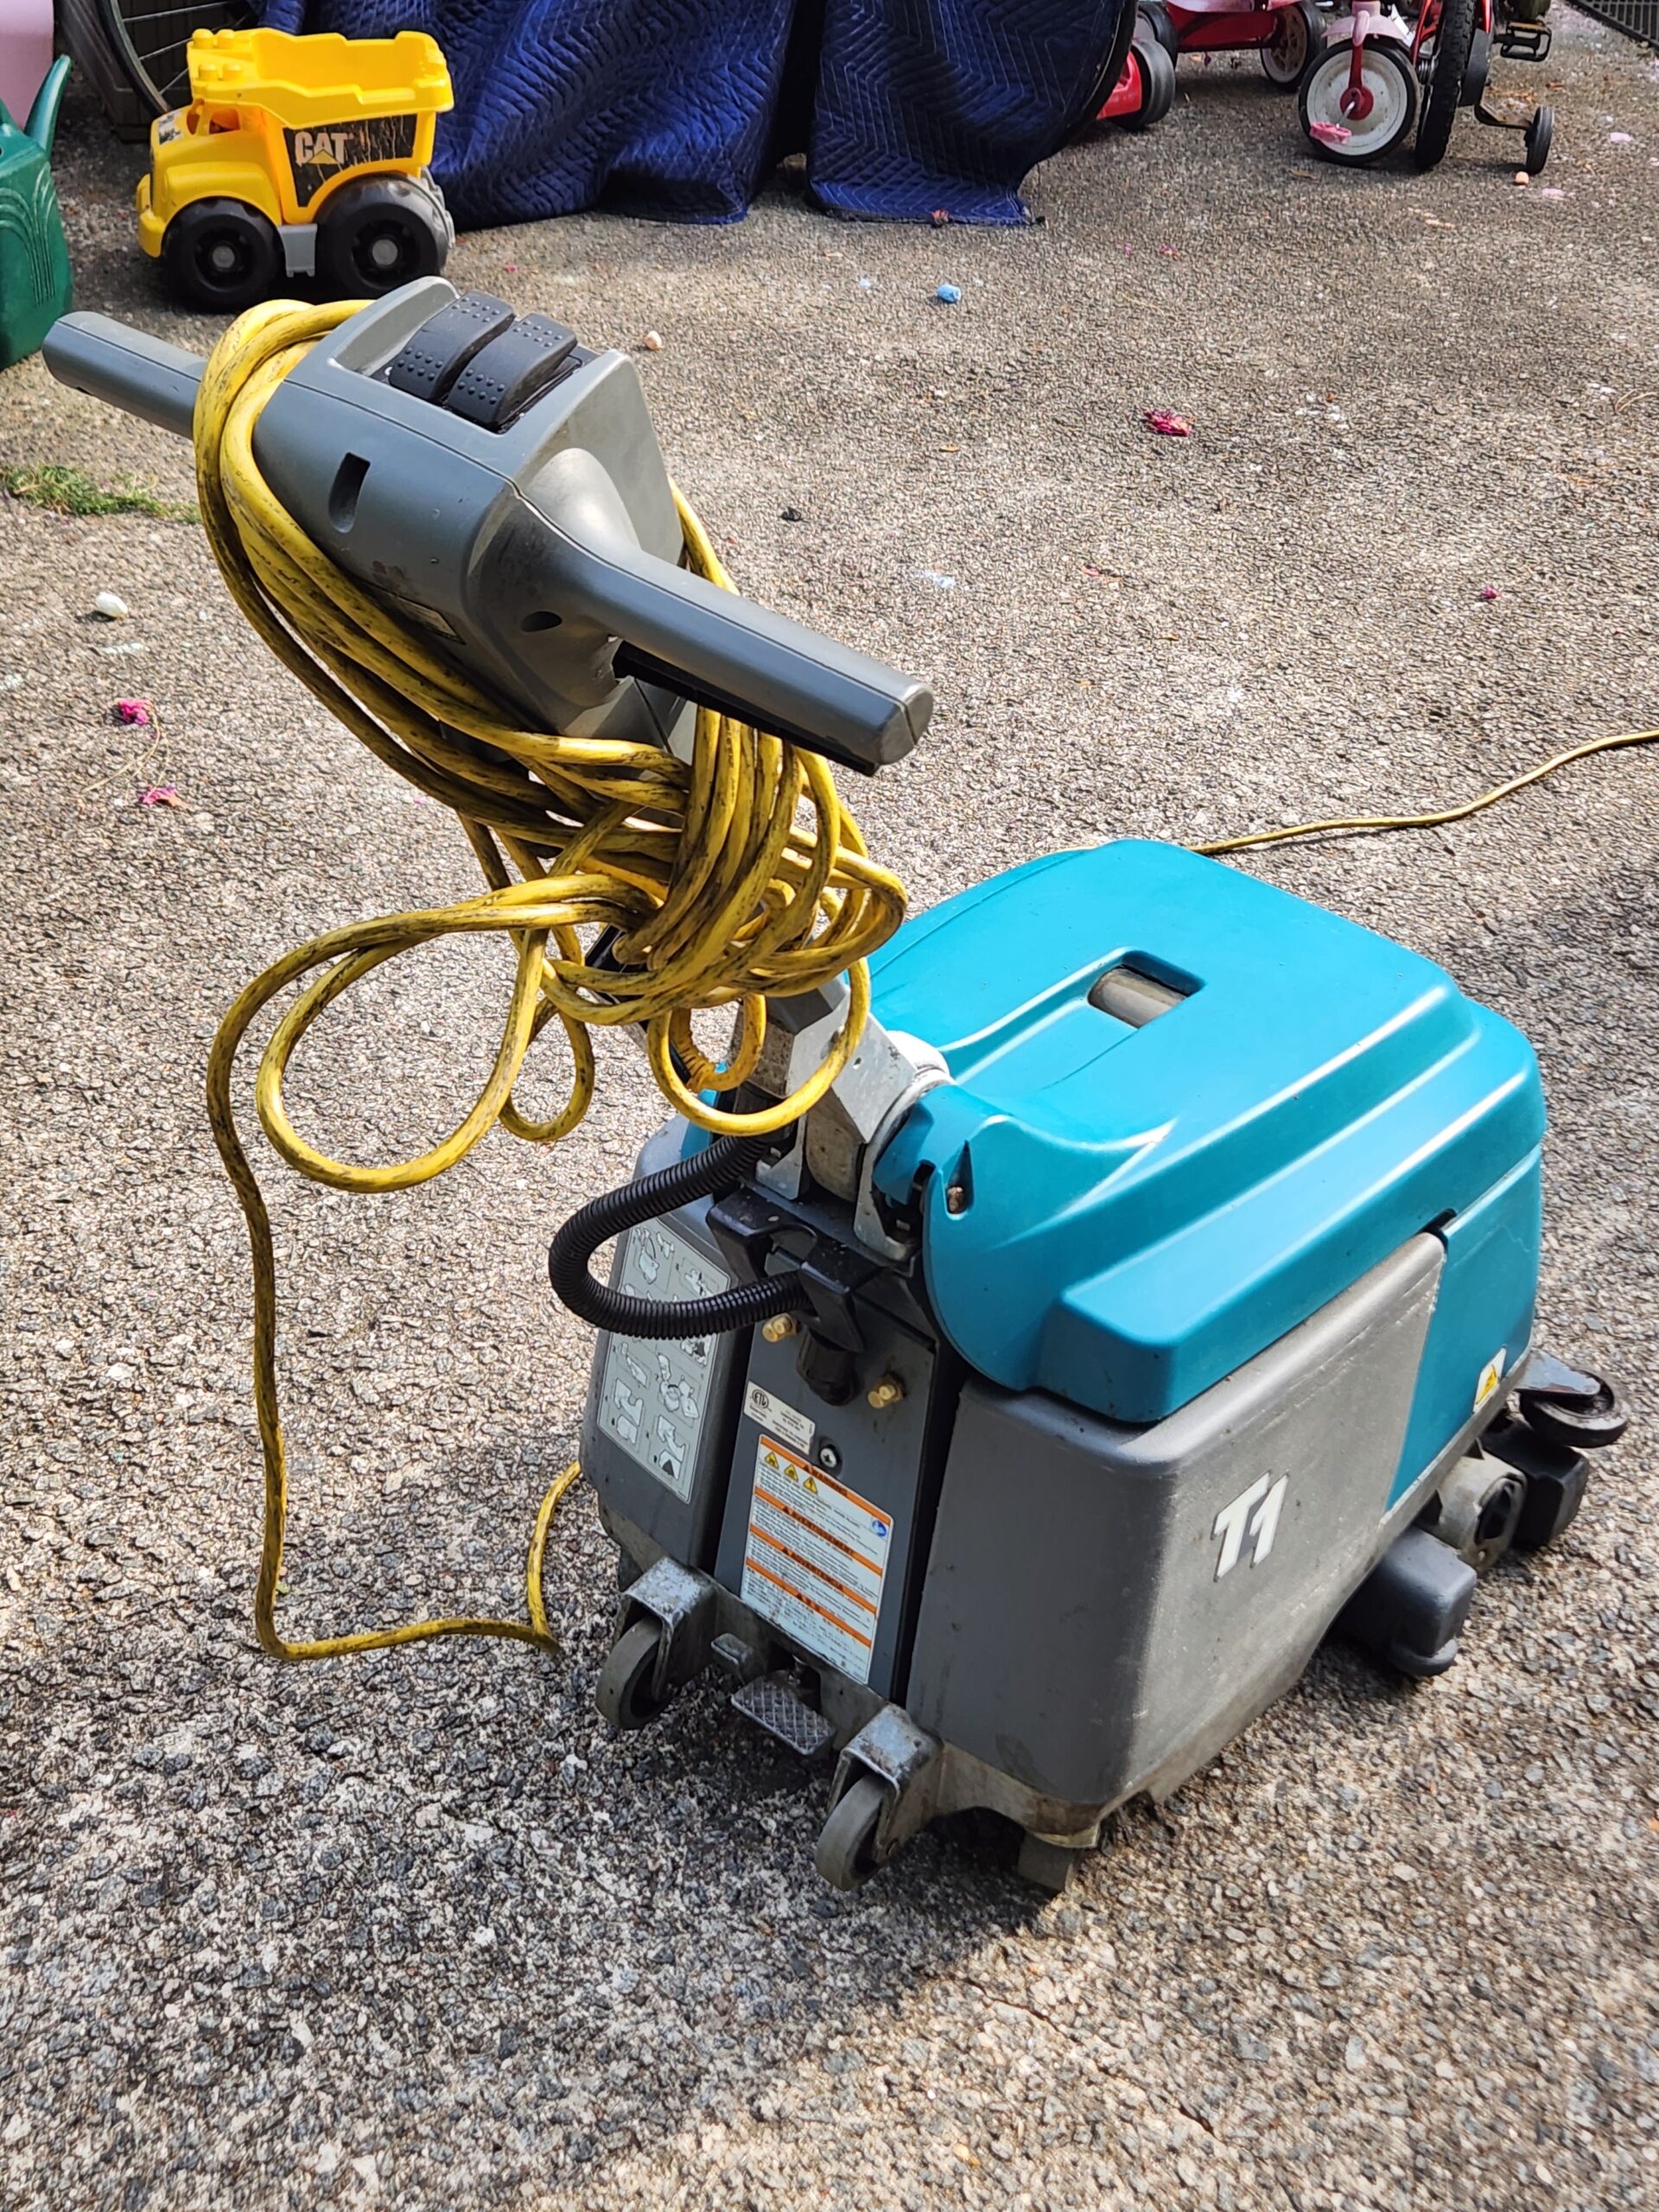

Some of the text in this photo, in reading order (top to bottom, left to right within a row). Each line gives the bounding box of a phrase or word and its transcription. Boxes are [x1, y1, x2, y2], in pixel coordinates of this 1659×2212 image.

[295, 131, 346, 166] CAT
[811, 1469, 848, 1497] WARNING
[1212, 1471, 1288, 1580] T1
